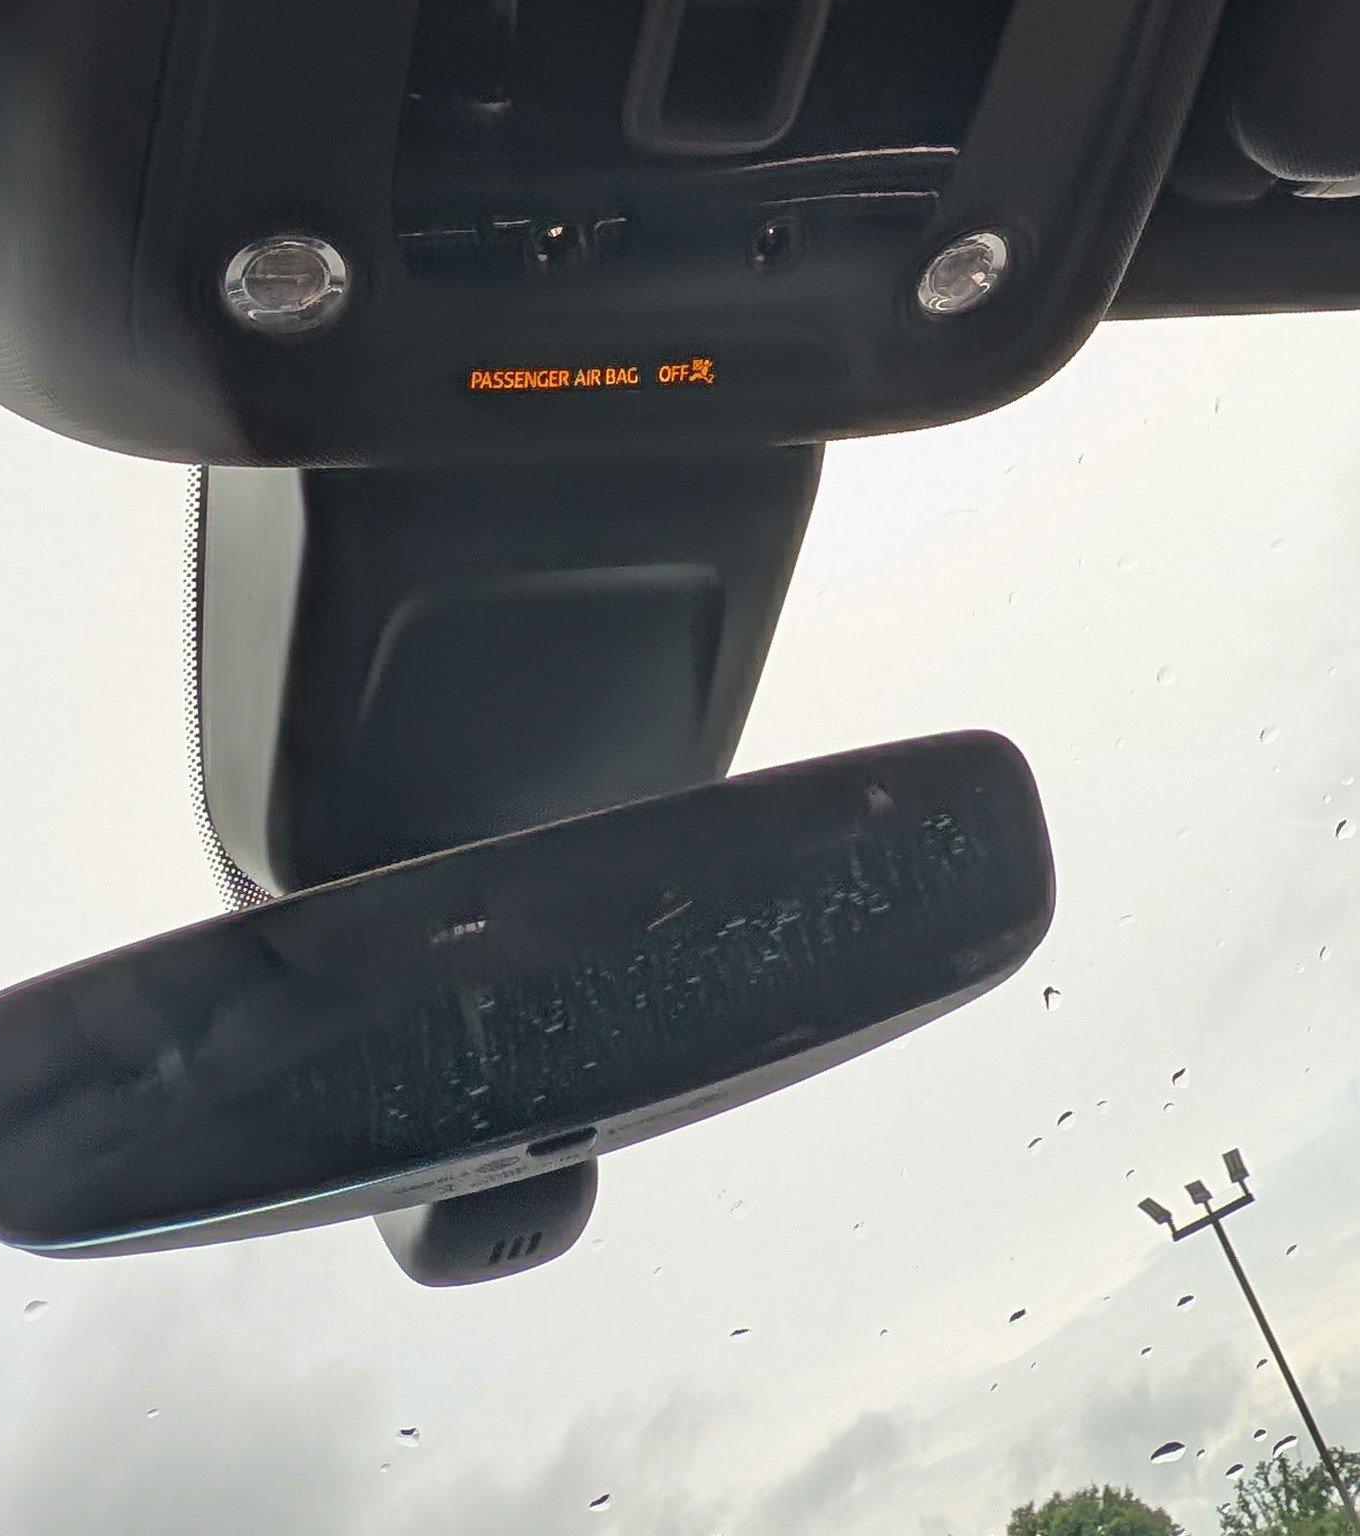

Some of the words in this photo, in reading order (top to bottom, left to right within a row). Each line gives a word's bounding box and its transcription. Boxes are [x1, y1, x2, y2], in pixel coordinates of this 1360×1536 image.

[470, 370, 569, 389] PASSENGER
[574, 369, 601, 386] AIR
[605, 367, 639, 385] BAG
[659, 364, 689, 383] OFF
